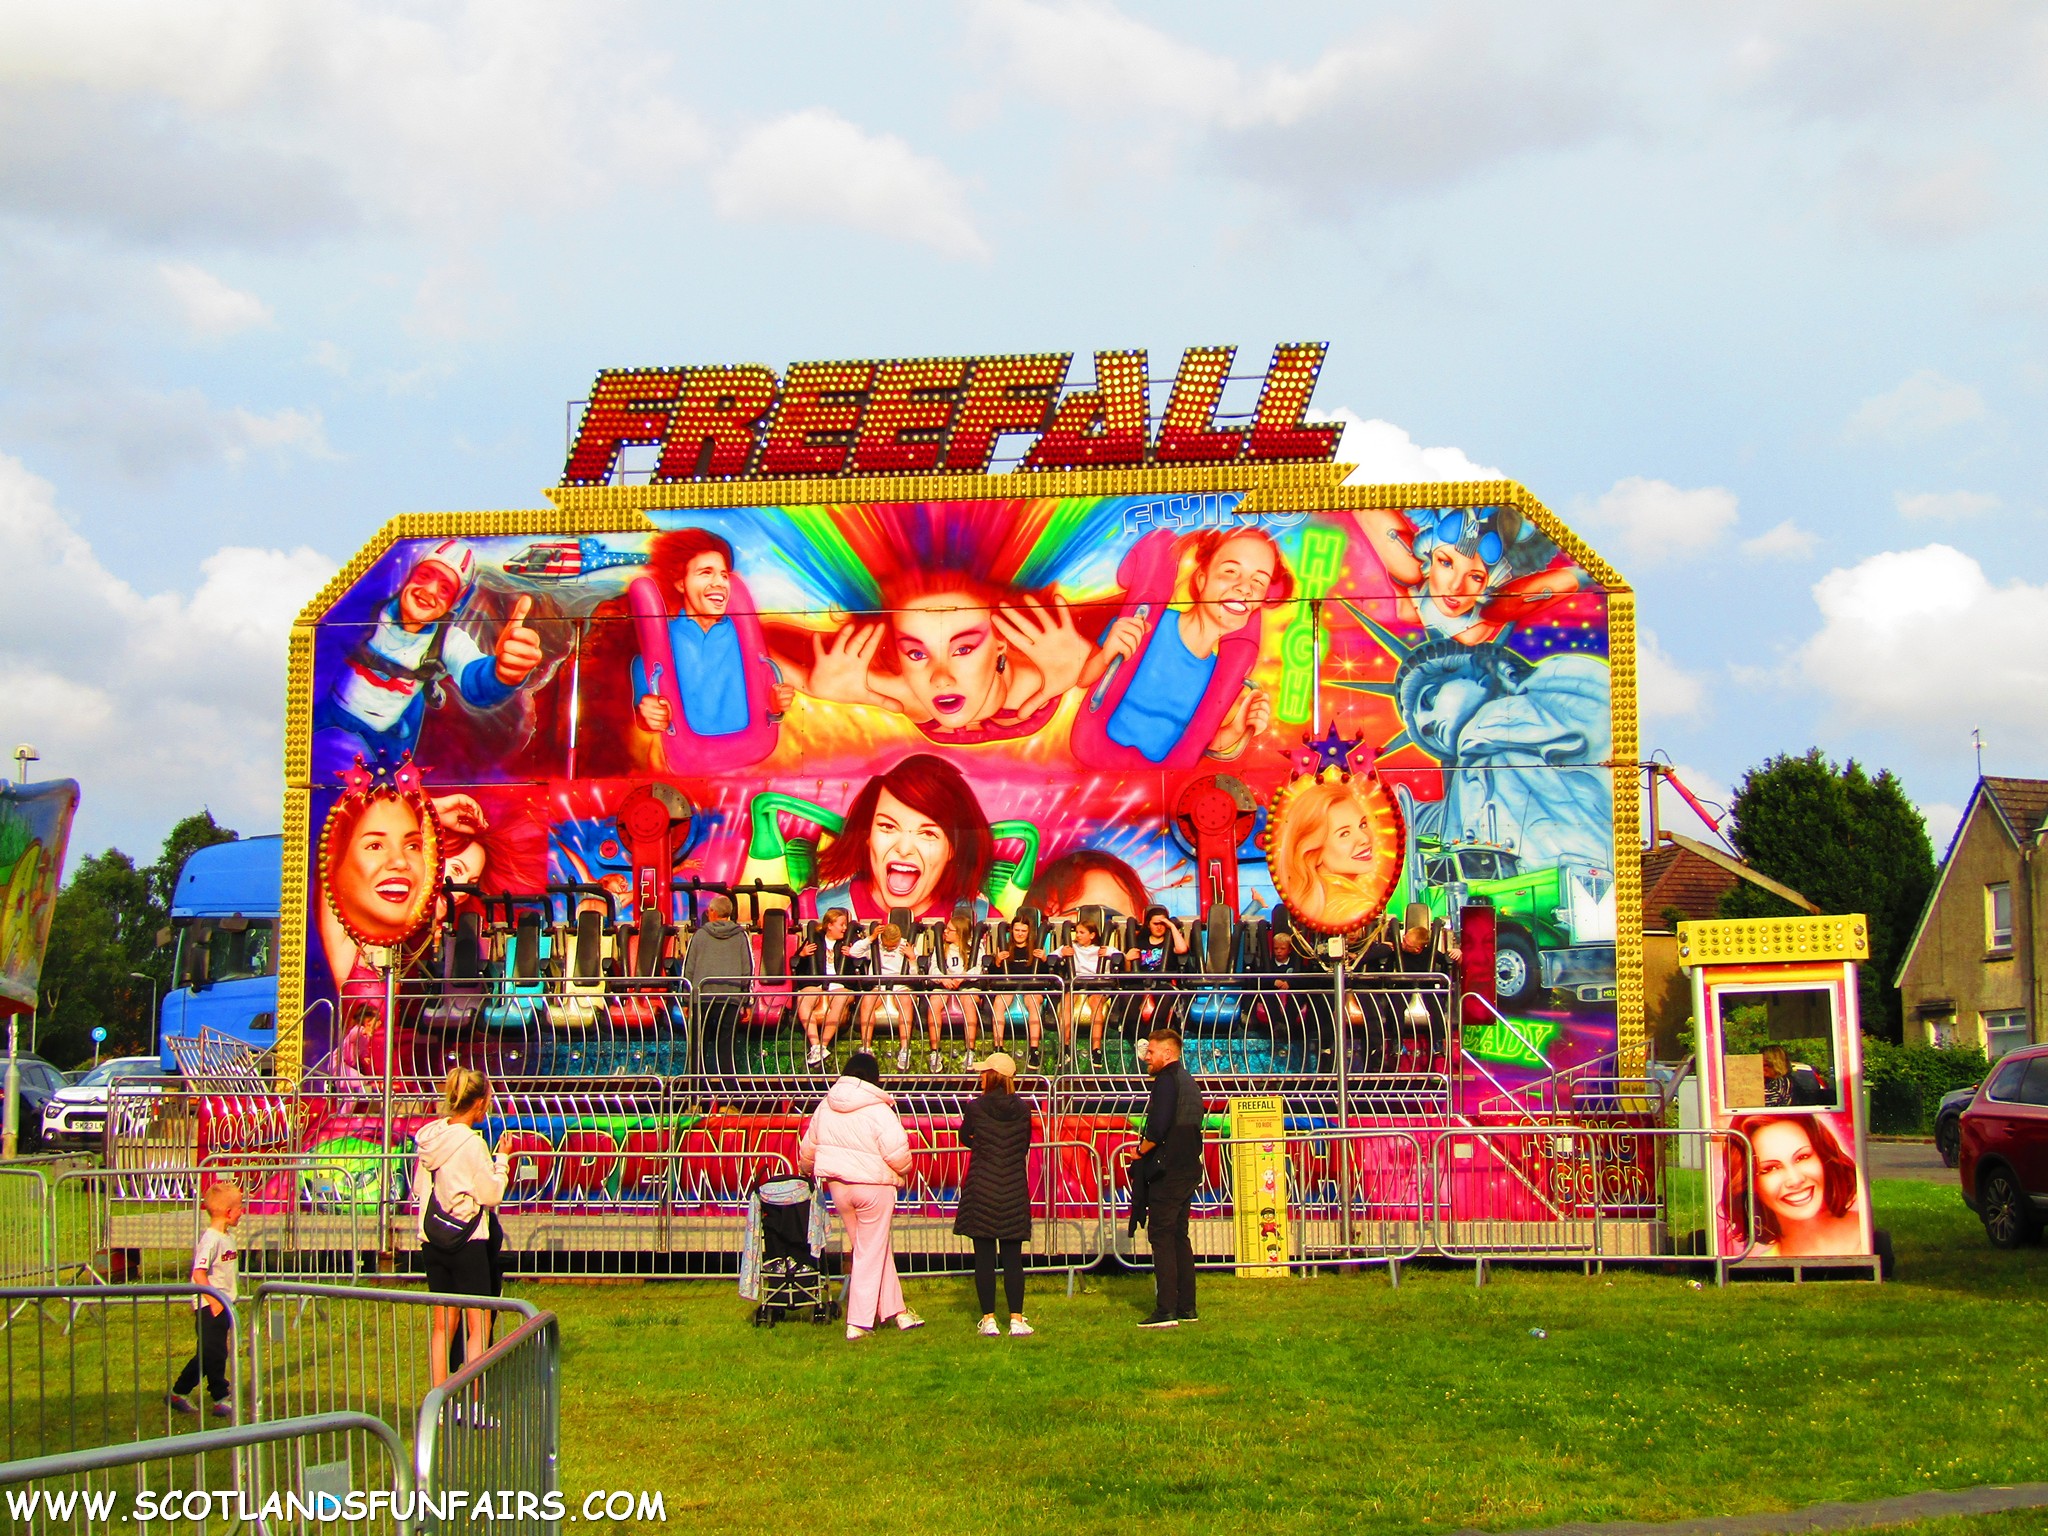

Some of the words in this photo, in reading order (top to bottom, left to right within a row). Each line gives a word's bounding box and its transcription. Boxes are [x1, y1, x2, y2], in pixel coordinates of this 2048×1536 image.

[558, 342, 1347, 487] FREEFALL
[1123, 493, 1308, 533] FLYIN
[1281, 532, 1343, 720] HIGH
[1237, 1100, 1276, 1110] FREEFALL
[1550, 1162, 1649, 1206] GOOD
